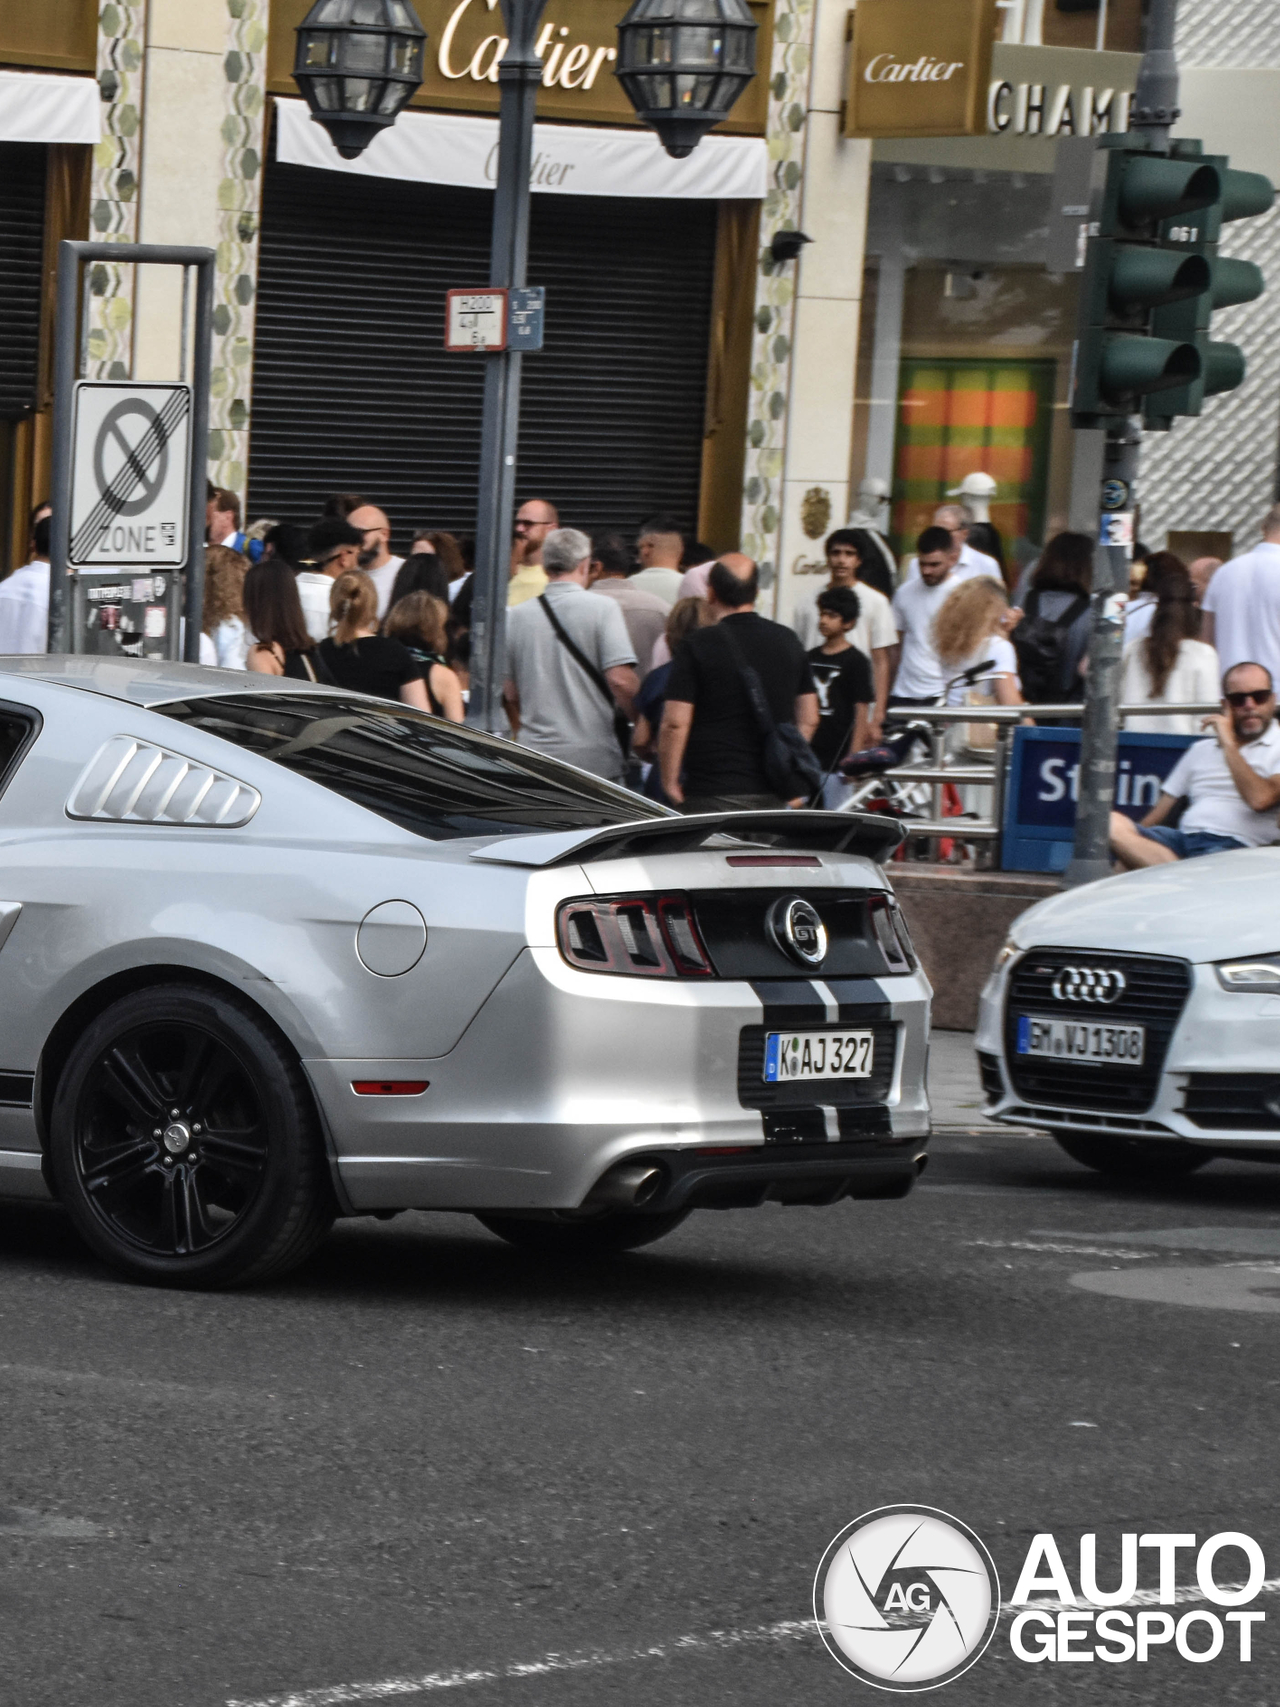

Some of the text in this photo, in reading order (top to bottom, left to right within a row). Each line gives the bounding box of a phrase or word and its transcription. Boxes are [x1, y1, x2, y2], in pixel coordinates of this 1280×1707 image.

[438, 0, 617, 90] Catier
[864, 54, 964, 83] Cartier
[99, 525, 156, 553] ZONE
[1038, 757, 1161, 806] Stin
[794, 924, 817, 941] GT
[780, 1039, 791, 1076] K
